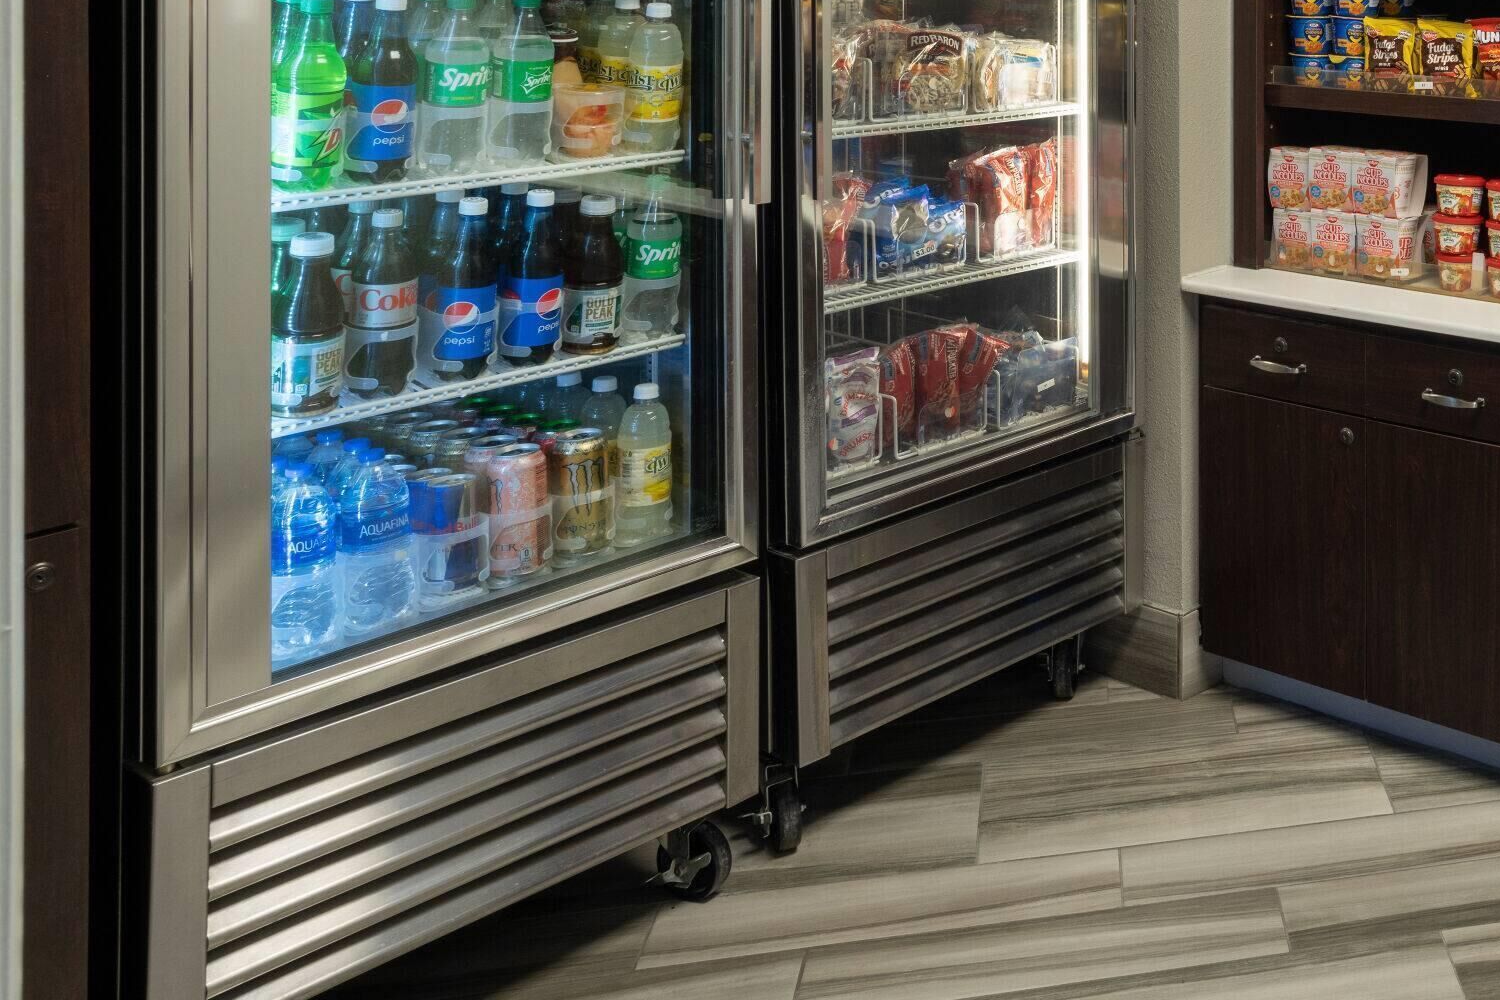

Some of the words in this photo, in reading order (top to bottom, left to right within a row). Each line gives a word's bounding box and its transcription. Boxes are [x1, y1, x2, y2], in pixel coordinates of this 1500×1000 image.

[1427, 42, 1454, 54] Fudge
[1427, 54, 1459, 65] Stripes
[373, 135, 404, 146] pepsi
[1280, 163, 1298, 171] CUP
[1322, 163, 1340, 171] CUP
[1365, 168, 1382, 176] CUP
[1273, 170, 1304, 181] NOODLES
[1314, 171, 1346, 182] NOODLES
[1357, 174, 1388, 186] NOODLES
[1286, 222, 1301, 231] CUP
[1323, 224, 1343, 233] CUP
[1279, 230, 1307, 240] NOODLES
[1317, 231, 1350, 242] NOODLES
[1368, 229, 1386, 238] CUP
[1363, 235, 1393, 248] NOODLES
[586, 297, 614, 308] GOLD
[586, 306, 614, 319] PEAK
[444, 336, 475, 346] pepsi
[359, 513, 409, 539] AQUAFINA
